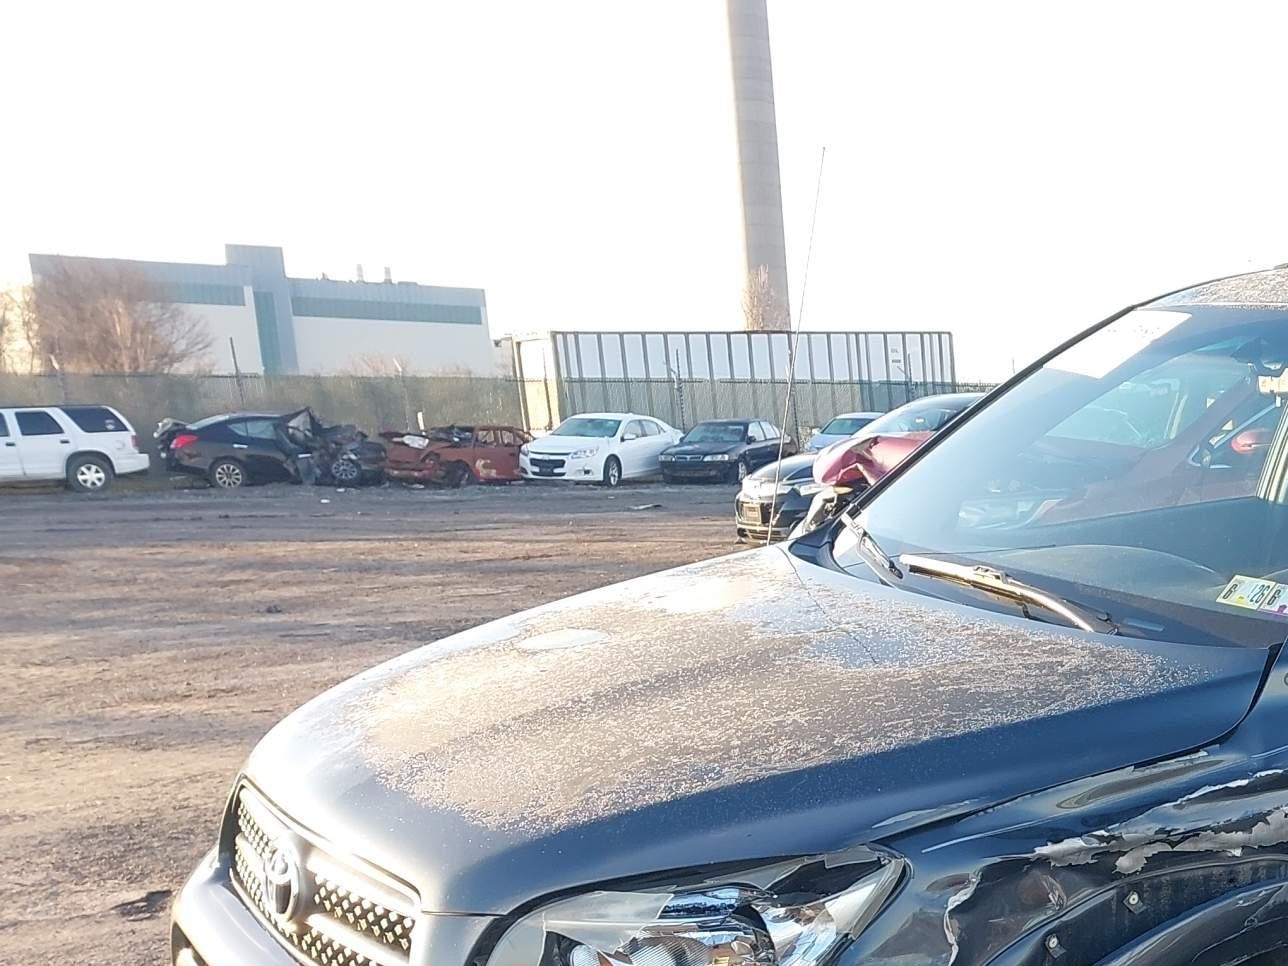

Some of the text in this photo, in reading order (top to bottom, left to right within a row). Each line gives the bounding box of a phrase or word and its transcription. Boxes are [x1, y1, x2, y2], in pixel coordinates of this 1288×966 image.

[1222, 583, 1271, 604] 6 26
[1267, 589, 1281, 606] 6
